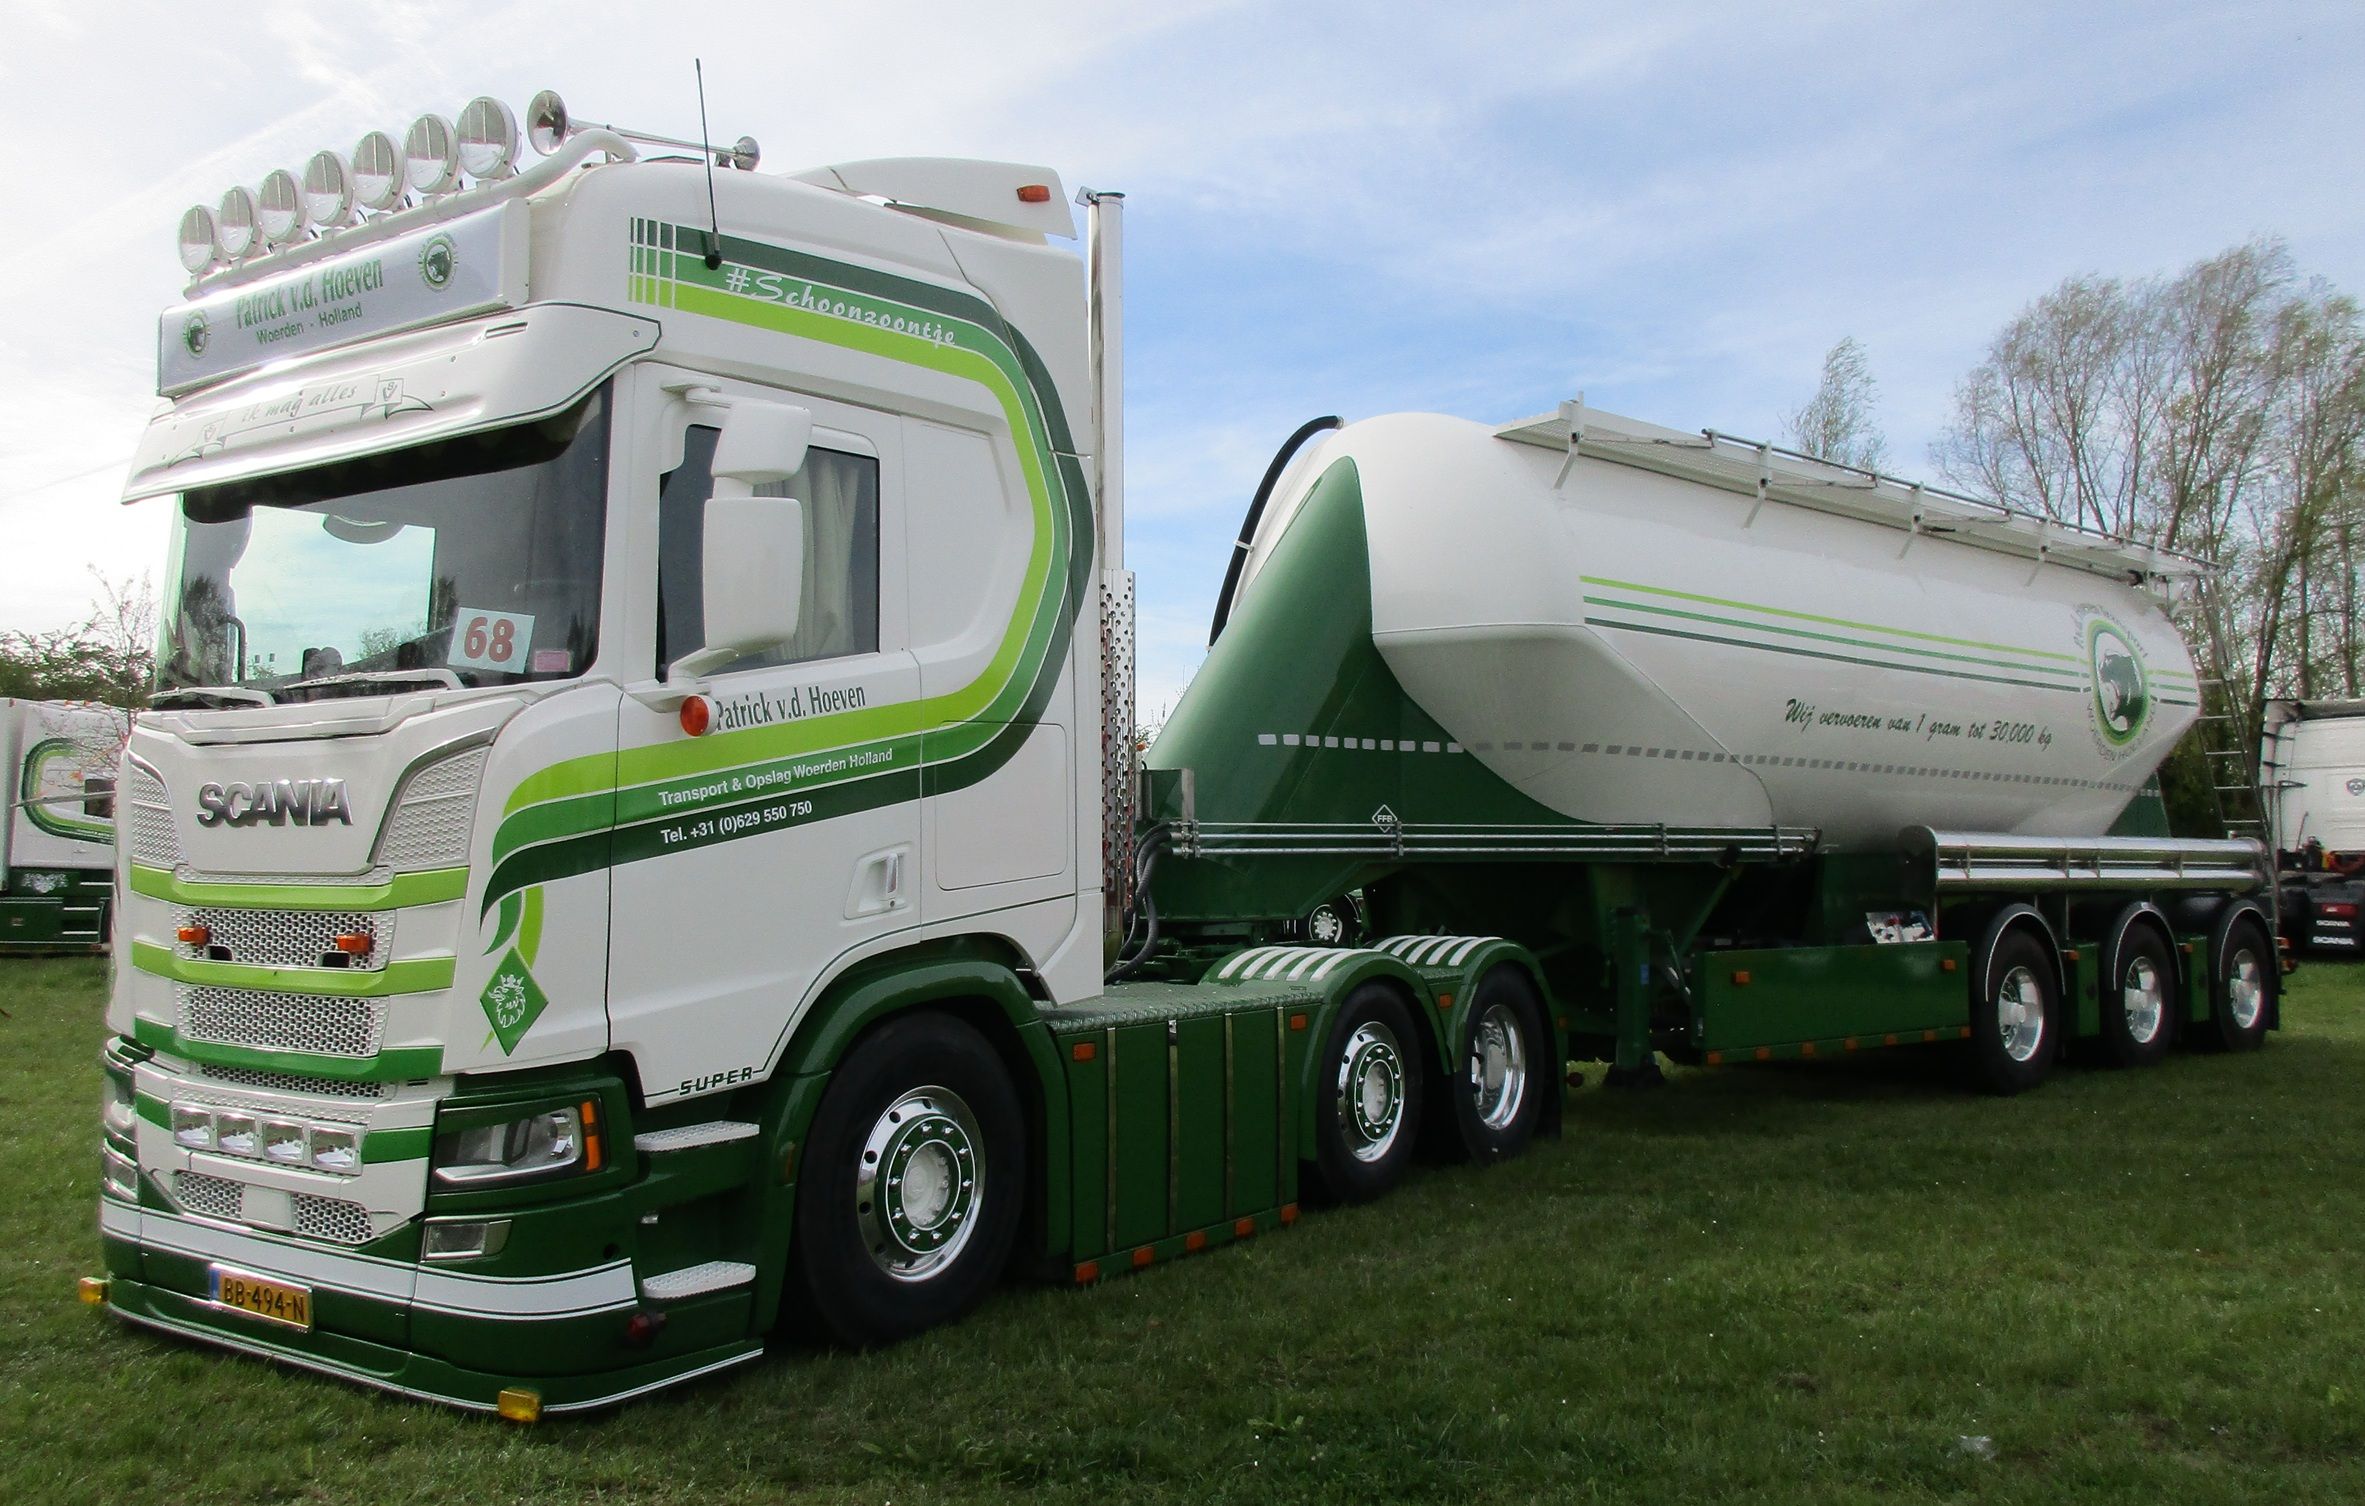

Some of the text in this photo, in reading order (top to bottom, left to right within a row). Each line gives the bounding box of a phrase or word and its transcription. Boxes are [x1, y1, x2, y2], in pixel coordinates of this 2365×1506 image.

[236, 284, 286, 330] Patrick
[290, 275, 318, 312] v.d.
[322, 258, 383, 303] Hoeven
[726, 268, 956, 348] #Schoonzoontje
[256, 320, 304, 345] Woerden
[319, 302, 363, 328] Holland
[266, 398, 303, 418] mag
[309, 384, 357, 406] alles
[464, 616, 515, 662] 68
[716, 686, 866, 731] Patrick v.d. Hoeven
[1786, 698, 1815, 732] Wij
[1819, 711, 1882, 730] vervoeren
[1887, 716, 1911, 733] van
[1928, 721, 1961, 742] gram
[1967, 721, 1986, 739] tot
[1989, 719, 2035, 744] 30.000
[2038, 724, 2053, 751] kg
[658, 748, 893, 806] Transport & Opslag Woerden Holland
[196, 778, 354, 829] SCANIA
[661, 800, 813, 844] Tel. +31 (0)629 550 750
[679, 1066, 753, 1096] SUPER
[223, 1277, 305, 1322] BB-494-N
